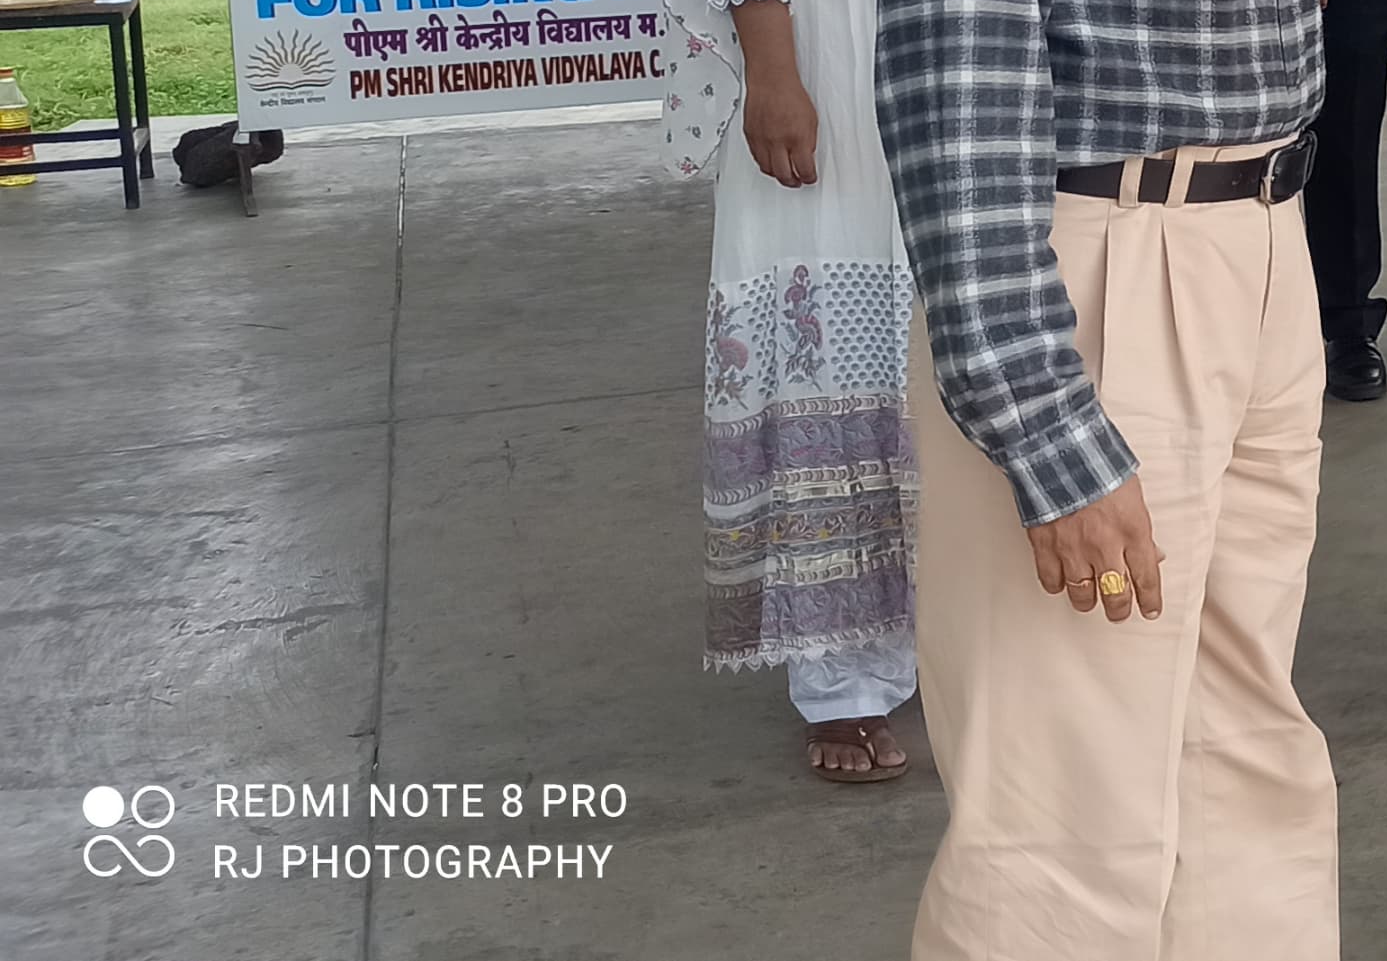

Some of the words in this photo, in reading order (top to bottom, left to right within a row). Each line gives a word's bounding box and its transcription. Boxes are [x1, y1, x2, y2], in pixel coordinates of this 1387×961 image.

[344, 18, 408, 61] पीएम
[415, 13, 449, 52] श्री
[454, 9, 531, 51] केन्द्रीय
[535, 7, 631, 46] विद्यालय
[350, 68, 382, 99] PM
[386, 65, 434, 97] SHRI
[439, 57, 538, 93] KENDRIYA
[541, 51, 646, 85] VIDYALAYA
